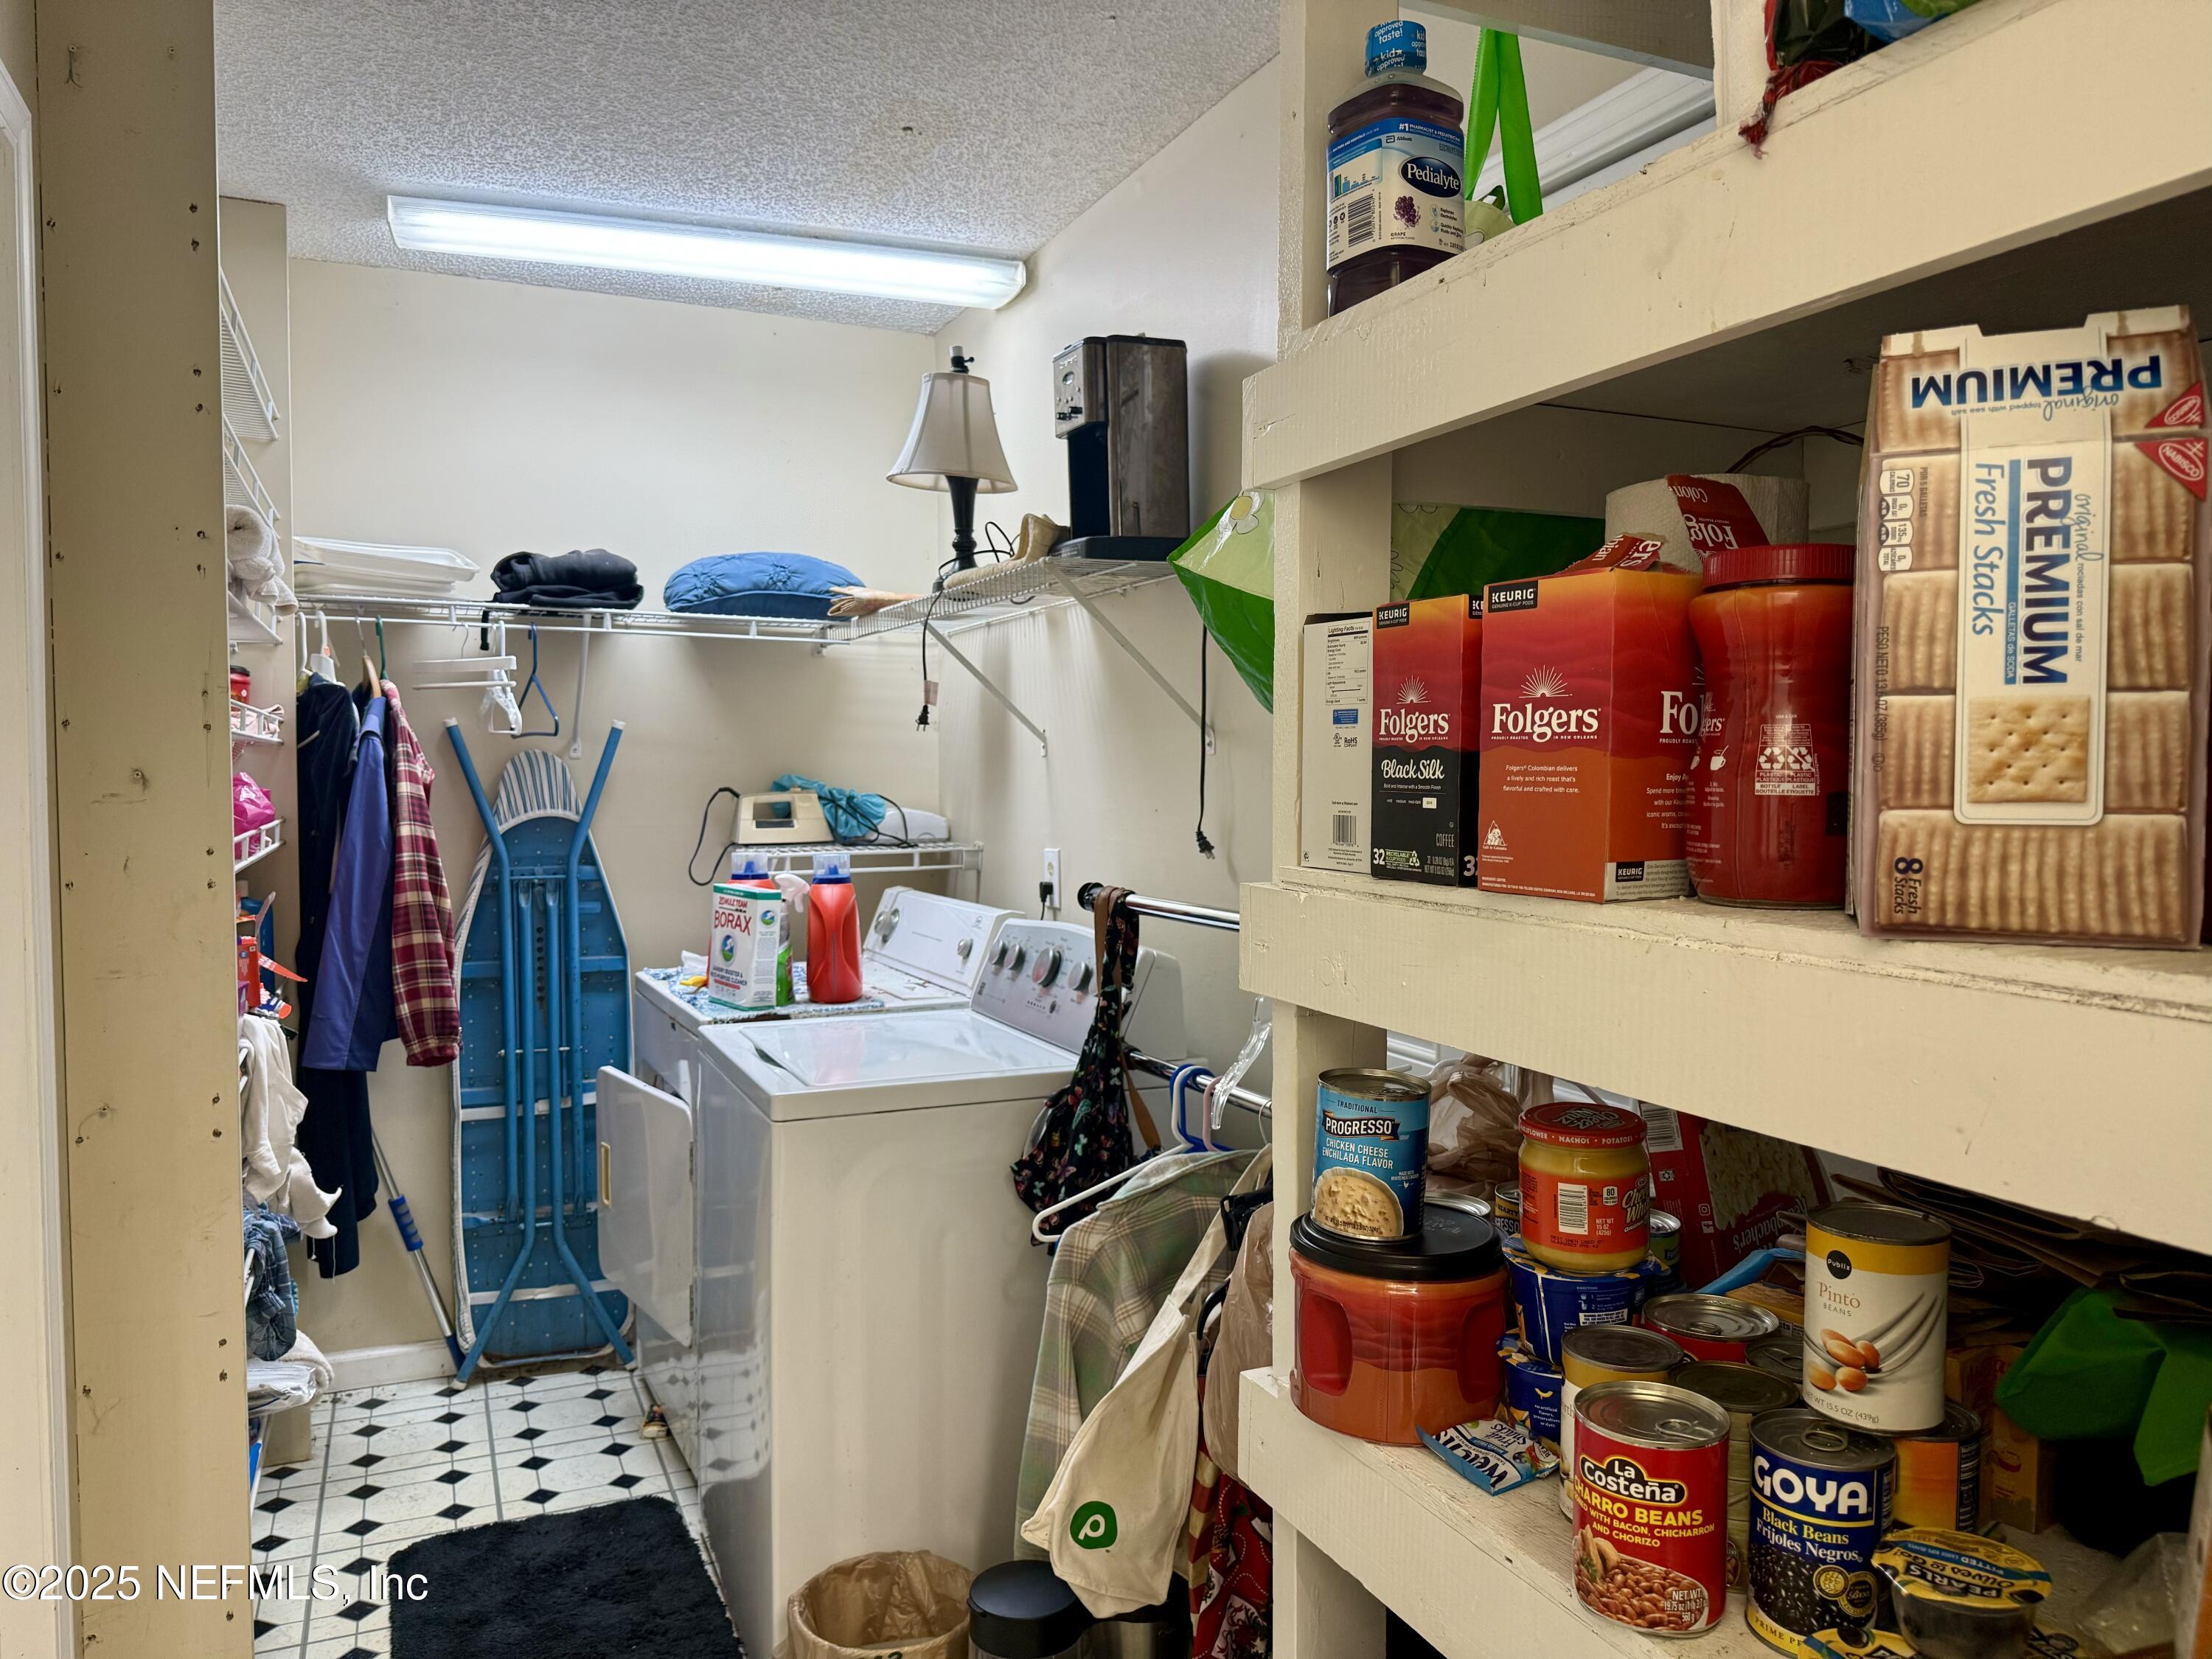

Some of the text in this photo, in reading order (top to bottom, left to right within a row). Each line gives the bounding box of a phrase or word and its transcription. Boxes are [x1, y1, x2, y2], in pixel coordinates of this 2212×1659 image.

[1379, 27, 1403, 44] taste!
[1377, 54, 1406, 72] approved
[1380, 48, 1395, 61] kid
[1399, 123, 1409, 131] #1
[1407, 163, 1459, 189] Pedialyte
[1911, 355, 2162, 409] PREMIUM
[1951, 408, 1965, 416] salt
[1988, 405, 2010, 413] with
[2011, 403, 2041, 411] topped
[2043, 386, 2119, 421] original
[2162, 445, 2200, 478] NABISCO
[1896, 473, 1910, 488] 70
[1919, 488, 1928, 518] GALLETAS
[2060, 493, 2104, 562] original
[1972, 462, 2006, 636] Fresh Stacks
[2023, 456, 2073, 684] PREMIUM
[2076, 563, 2085, 599] rociadas
[1492, 588, 1534, 603] KEURIG
[1378, 608, 1407, 621] KEURIG
[2076, 618, 2085, 630] sal
[2006, 602, 2017, 678] GALLETAS de SODA
[2076, 632, 2085, 644] de
[1875, 626, 1889, 712] PESO NETO OZ
[1379, 709, 1450, 743] Folgers
[1491, 703, 1599, 743] Folgers
[1381, 759, 1444, 779] Black Silk
[1666, 773, 1681, 782] Enjoy
[1436, 833, 1455, 848] COFFEE
[1373, 848, 1385, 866] 32
[1894, 857, 1924, 875] 8
[1618, 868, 1643, 876] KEURIG
[736, 899, 748, 908] TEAM
[1894, 876, 1907, 914] Stacks
[1907, 877, 1921, 914] Fresh
[714, 910, 752, 936] BORAX
[1337, 1099, 1378, 1114] TRADITIONAL
[1326, 1116, 1392, 1135] PROGRESSO
[1326, 1138, 1388, 1158] CHICKEN CHEESE
[1559, 1135, 1633, 1144] NACHOS POTATOES
[1322, 1147, 1394, 1169] ENCHILADA FLAVOR
[1606, 1188, 1615, 1196] 80
[1818, 1281, 1860, 1309] Pinto
[1823, 1302, 1852, 1317] BEANS
[1814, 1396, 1879, 1425] WT 15.5 OZ (439g)
[1485, 1431, 1517, 1448] Fruit
[1490, 1423, 1526, 1445] Snacks
[1490, 1453, 1506, 1466] FAMILY
[1614, 1460, 1635, 1479] La
[1584, 1461, 1676, 1503] Costeña
[1753, 1455, 1868, 1514] GOYA
[1573, 1477, 1703, 1526] CHARRO BEANS
[1590, 1507, 1715, 1538] WITH BACON, CHICHARRON
[1762, 1506, 1849, 1545] Black Beans
[1593, 1521, 1660, 1548] AND CHORIZO
[1756, 1517, 1859, 1563] Frijoles Negros
[1892, 1548, 2014, 1588] Olives to Go!
[1961, 1556, 2005, 1575] PITTED
[1910, 1563, 1998, 1596] PEARLS
[1672, 1590, 1688, 1601] NET
[1664, 1601, 1685, 1611] 19.75 oz
[1682, 1611, 1691, 1622] 560
[1755, 1615, 1784, 1641] PRIME
